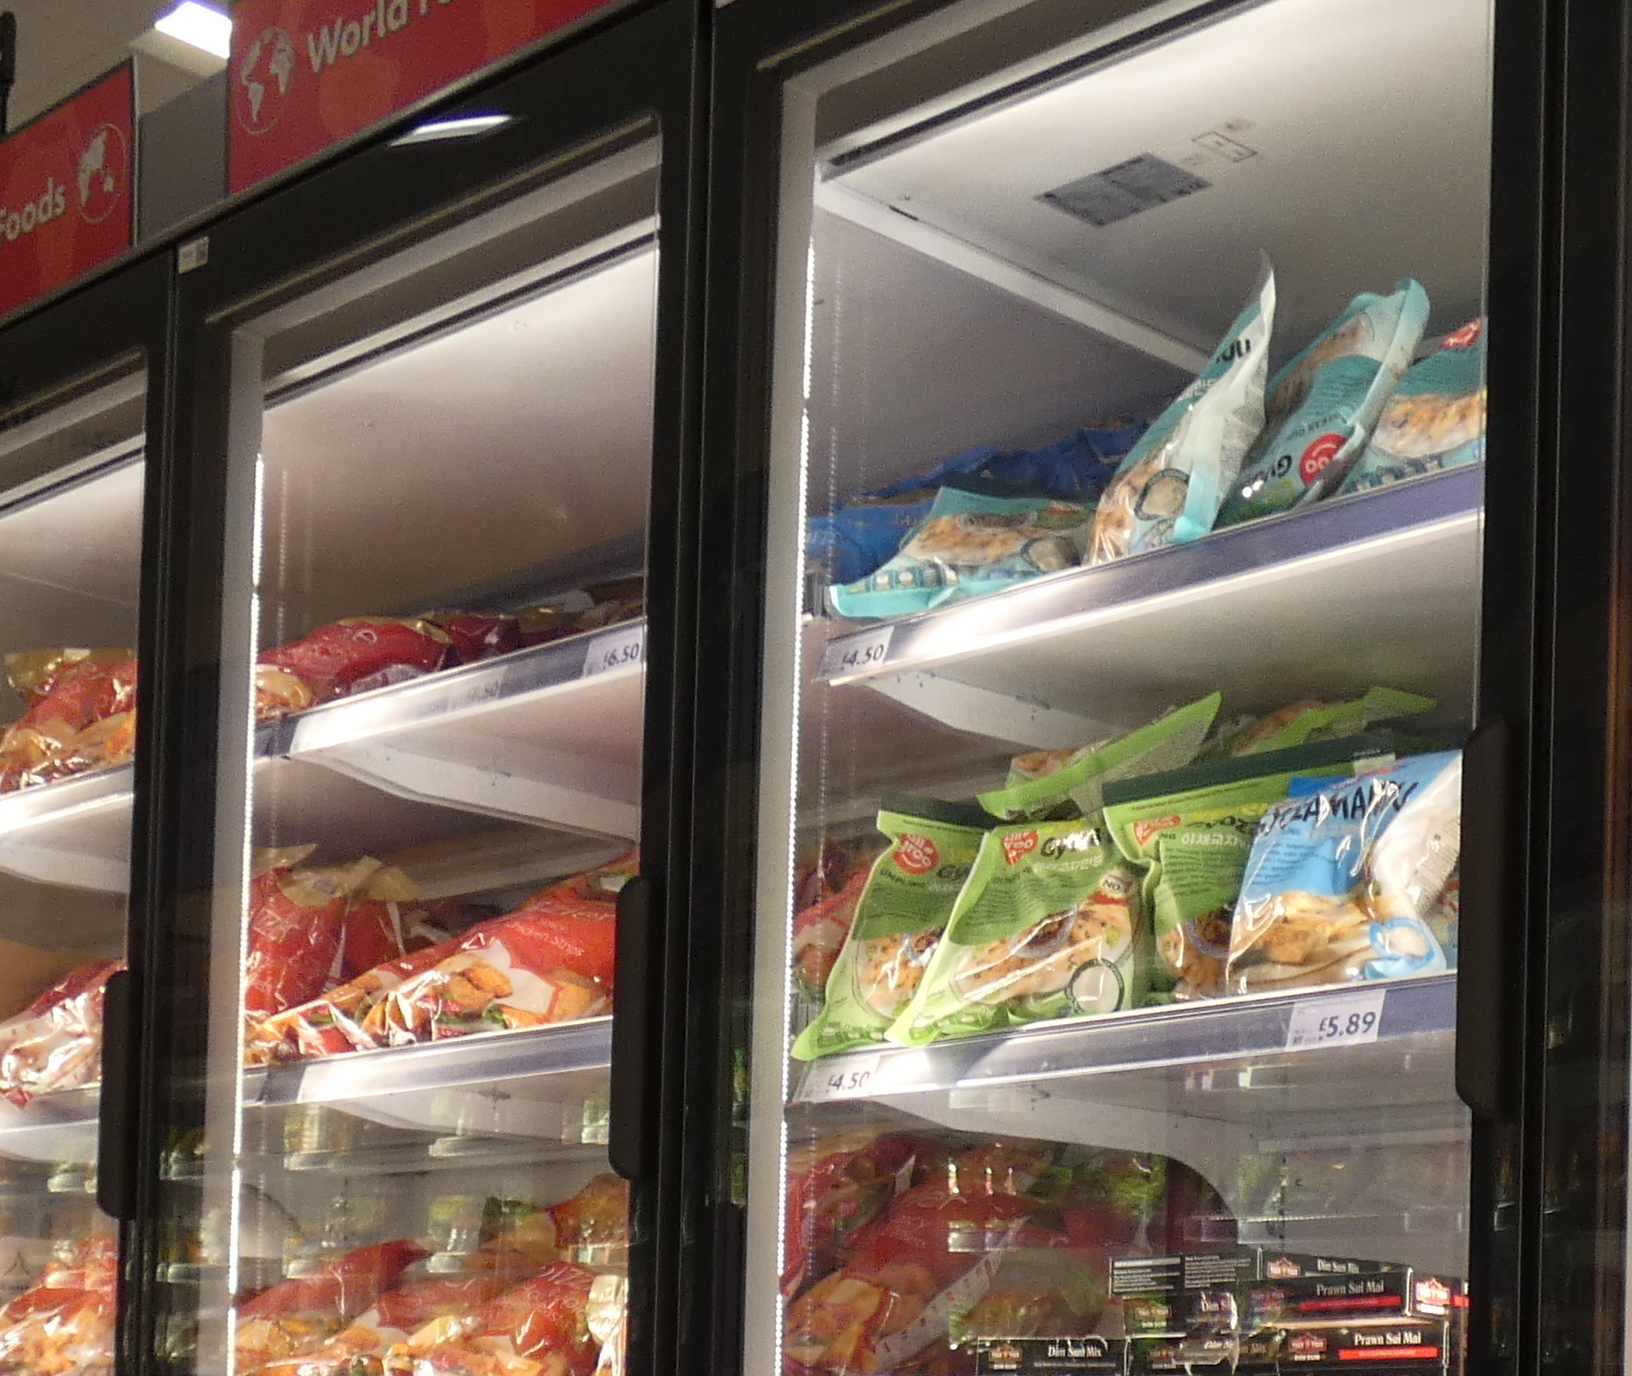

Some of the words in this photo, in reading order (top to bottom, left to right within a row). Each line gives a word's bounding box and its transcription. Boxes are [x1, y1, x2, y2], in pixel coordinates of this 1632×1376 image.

[307, 0, 410, 73] World
[1318, 1012, 1377, 1038] £5.89
[1317, 1283, 1347, 1297] Prawn
[1349, 1281, 1363, 1294] Sui
[1365, 1279, 1385, 1294] Mai
[1354, 1333, 1384, 1346] Prawn
[1386, 1332, 1401, 1345] Sui
[1403, 1331, 1422, 1345] Mai
[1048, 1340, 1066, 1359] Dim
[1068, 1340, 1084, 1359] Sum
[1086, 1341, 1102, 1358] Mix
